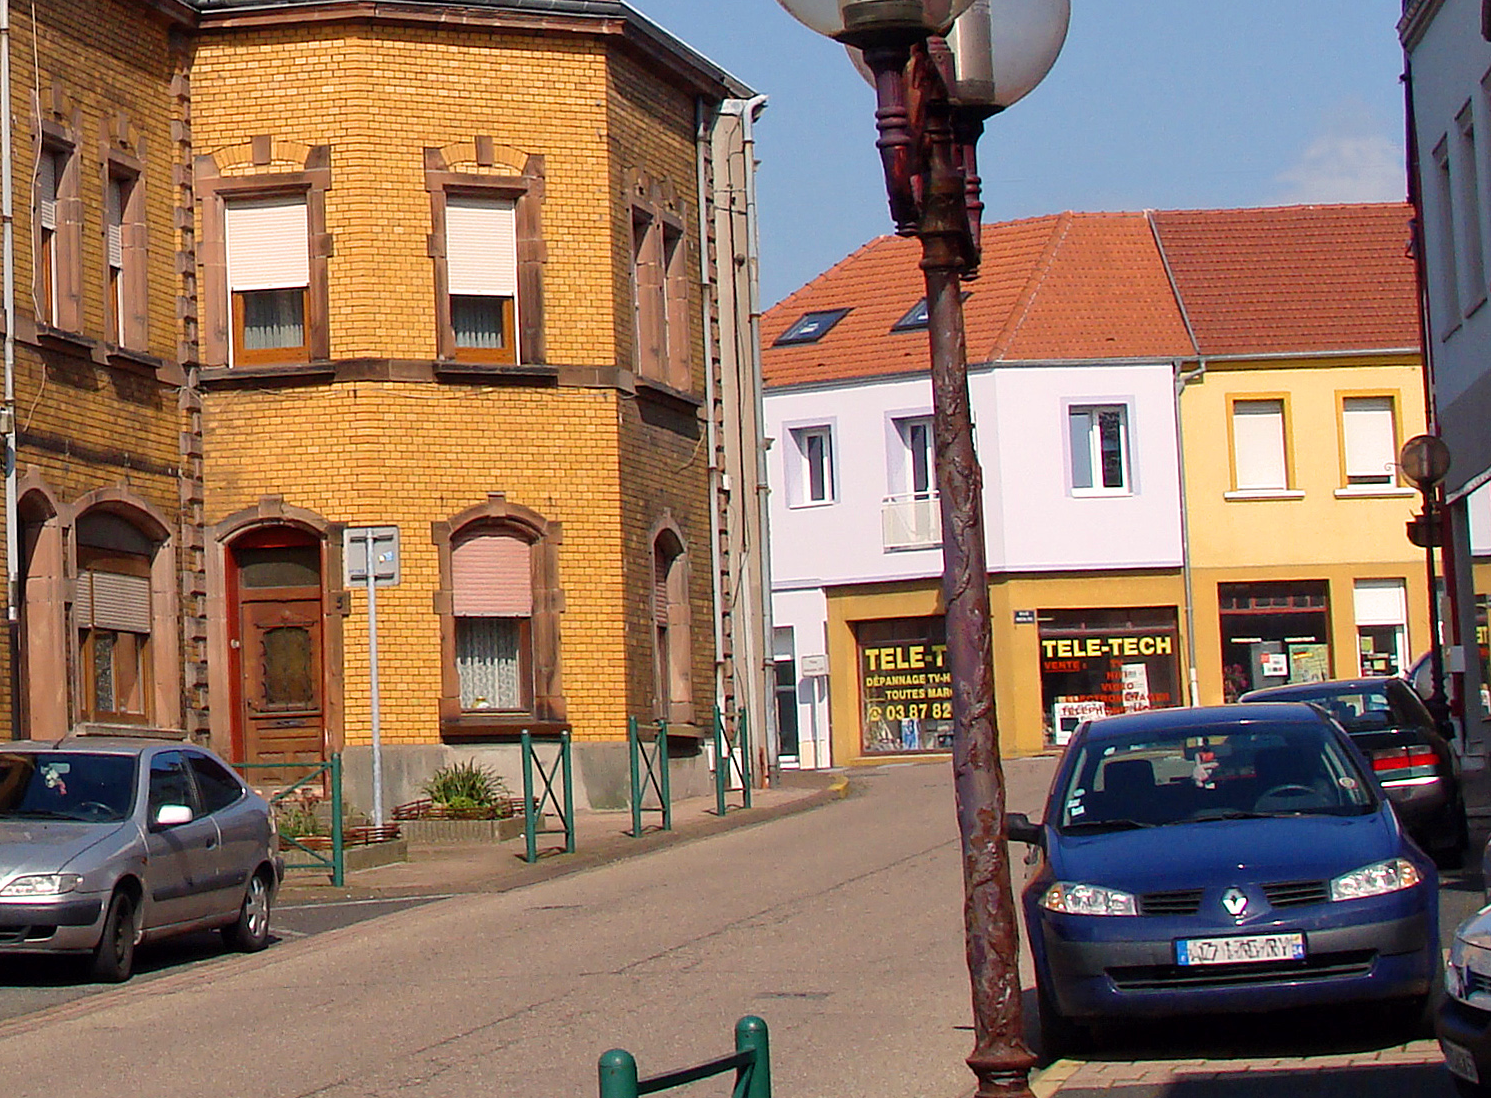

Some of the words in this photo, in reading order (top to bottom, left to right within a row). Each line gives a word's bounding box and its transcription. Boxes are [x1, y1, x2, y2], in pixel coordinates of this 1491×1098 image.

[1042, 636, 1172, 657] TELE-TECH
[1044, 660, 1080, 670] VENTE
[866, 674, 926, 687] DÉPANNAGE
[885, 688, 925, 700] TOUTES
[886, 704, 905, 720] 03
[909, 703, 928, 719] 87
[932, 702, 952, 719] 82
